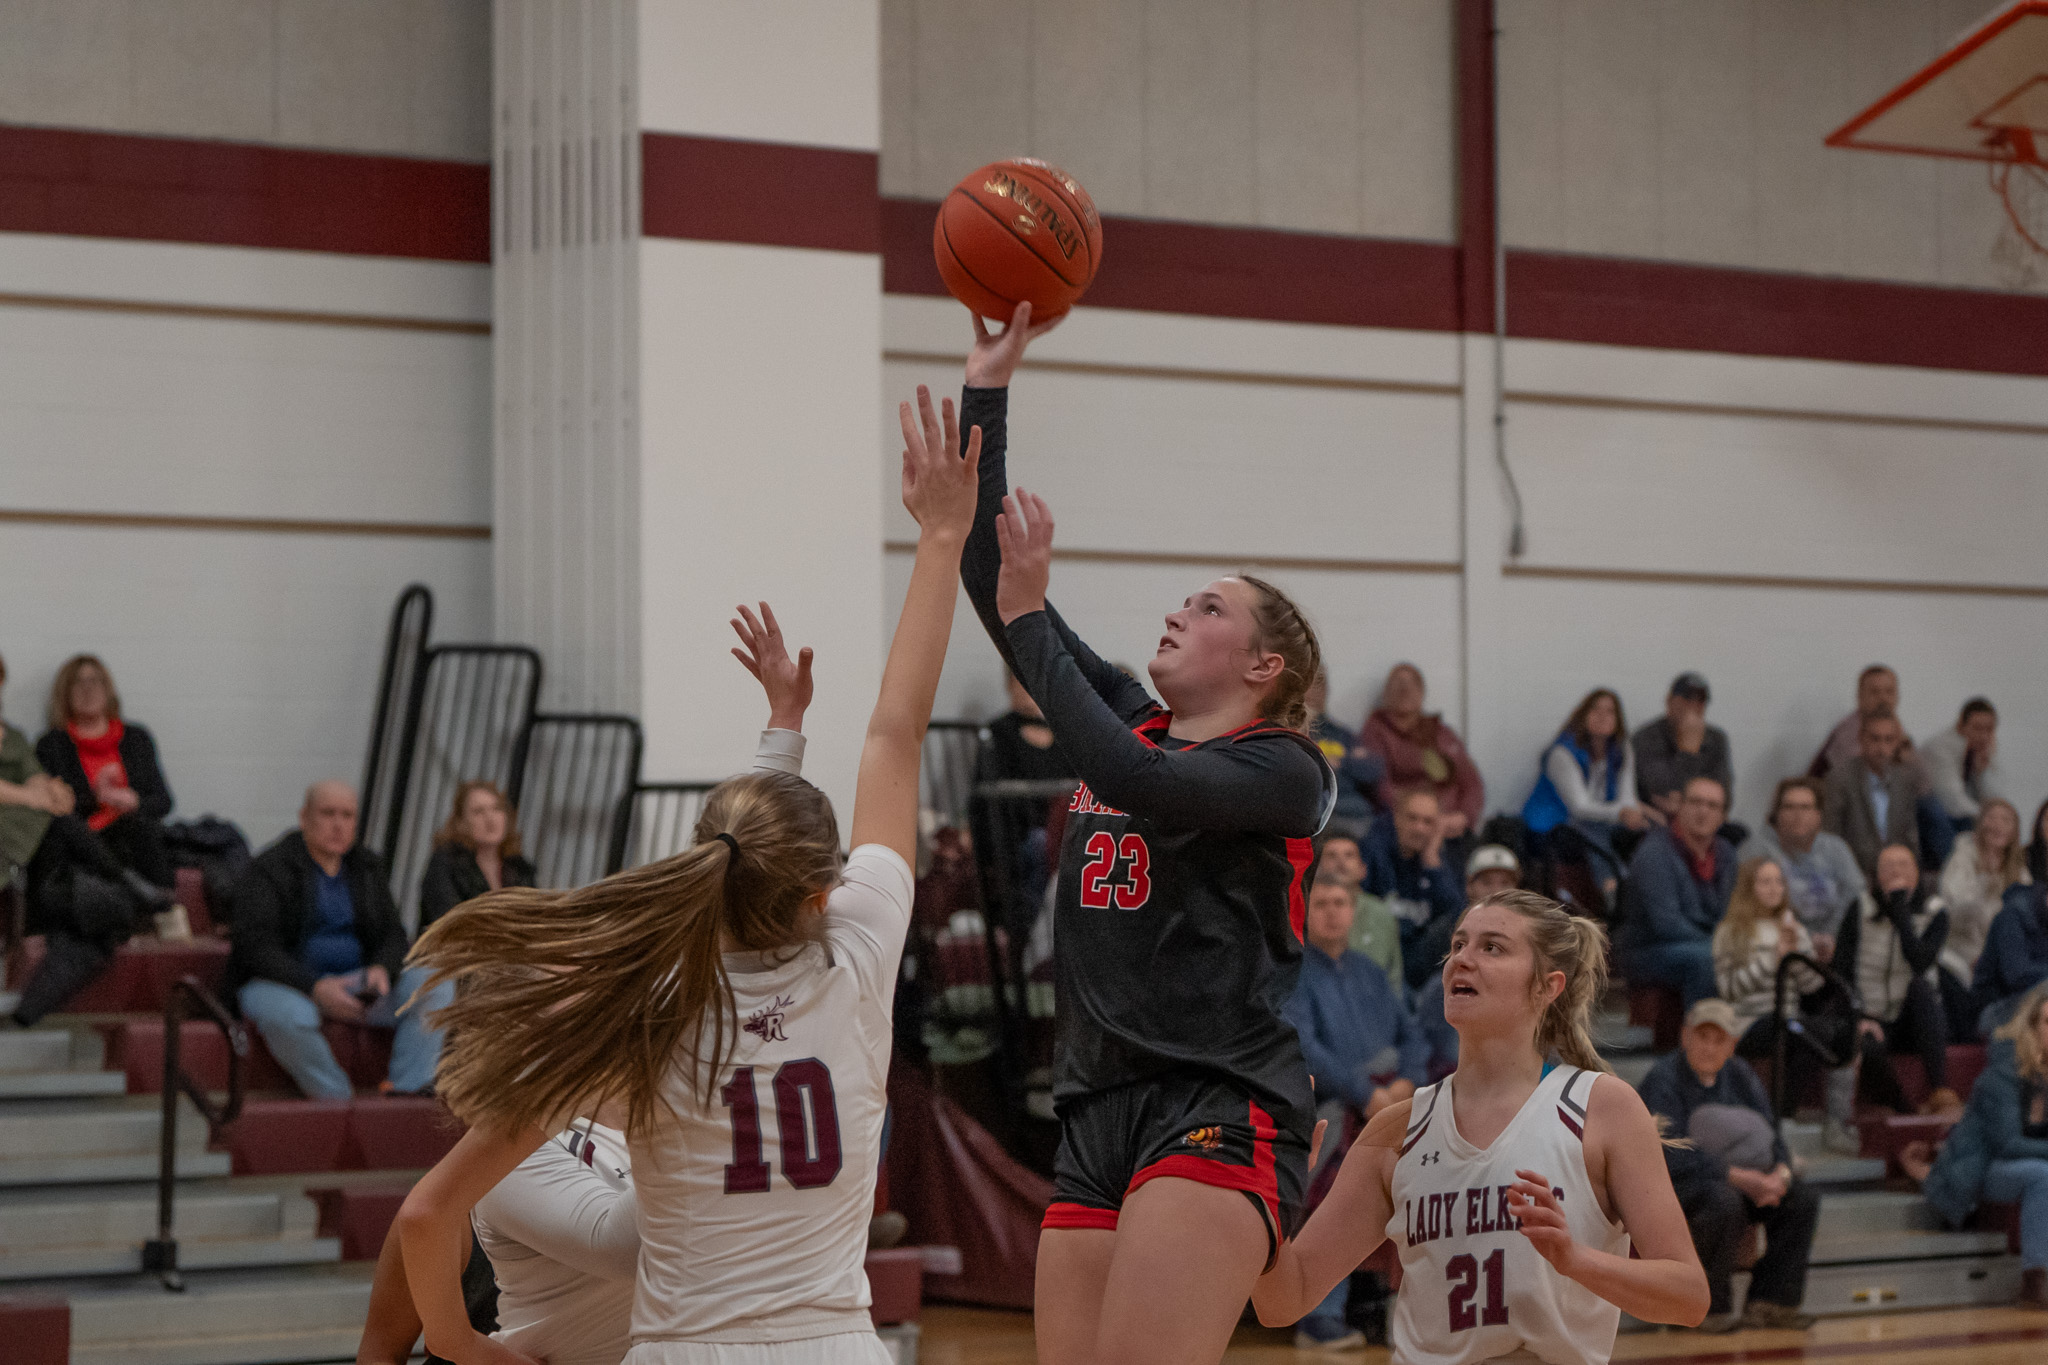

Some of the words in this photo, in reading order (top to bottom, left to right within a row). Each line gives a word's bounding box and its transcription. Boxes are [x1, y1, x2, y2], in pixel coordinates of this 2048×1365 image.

[1080, 831, 1151, 911] 23
[763, 1013, 789, 1042] R
[720, 1057, 843, 1195] 10
[1405, 1191, 1460, 1247] LADY
[1445, 1248, 1509, 1334] 21
